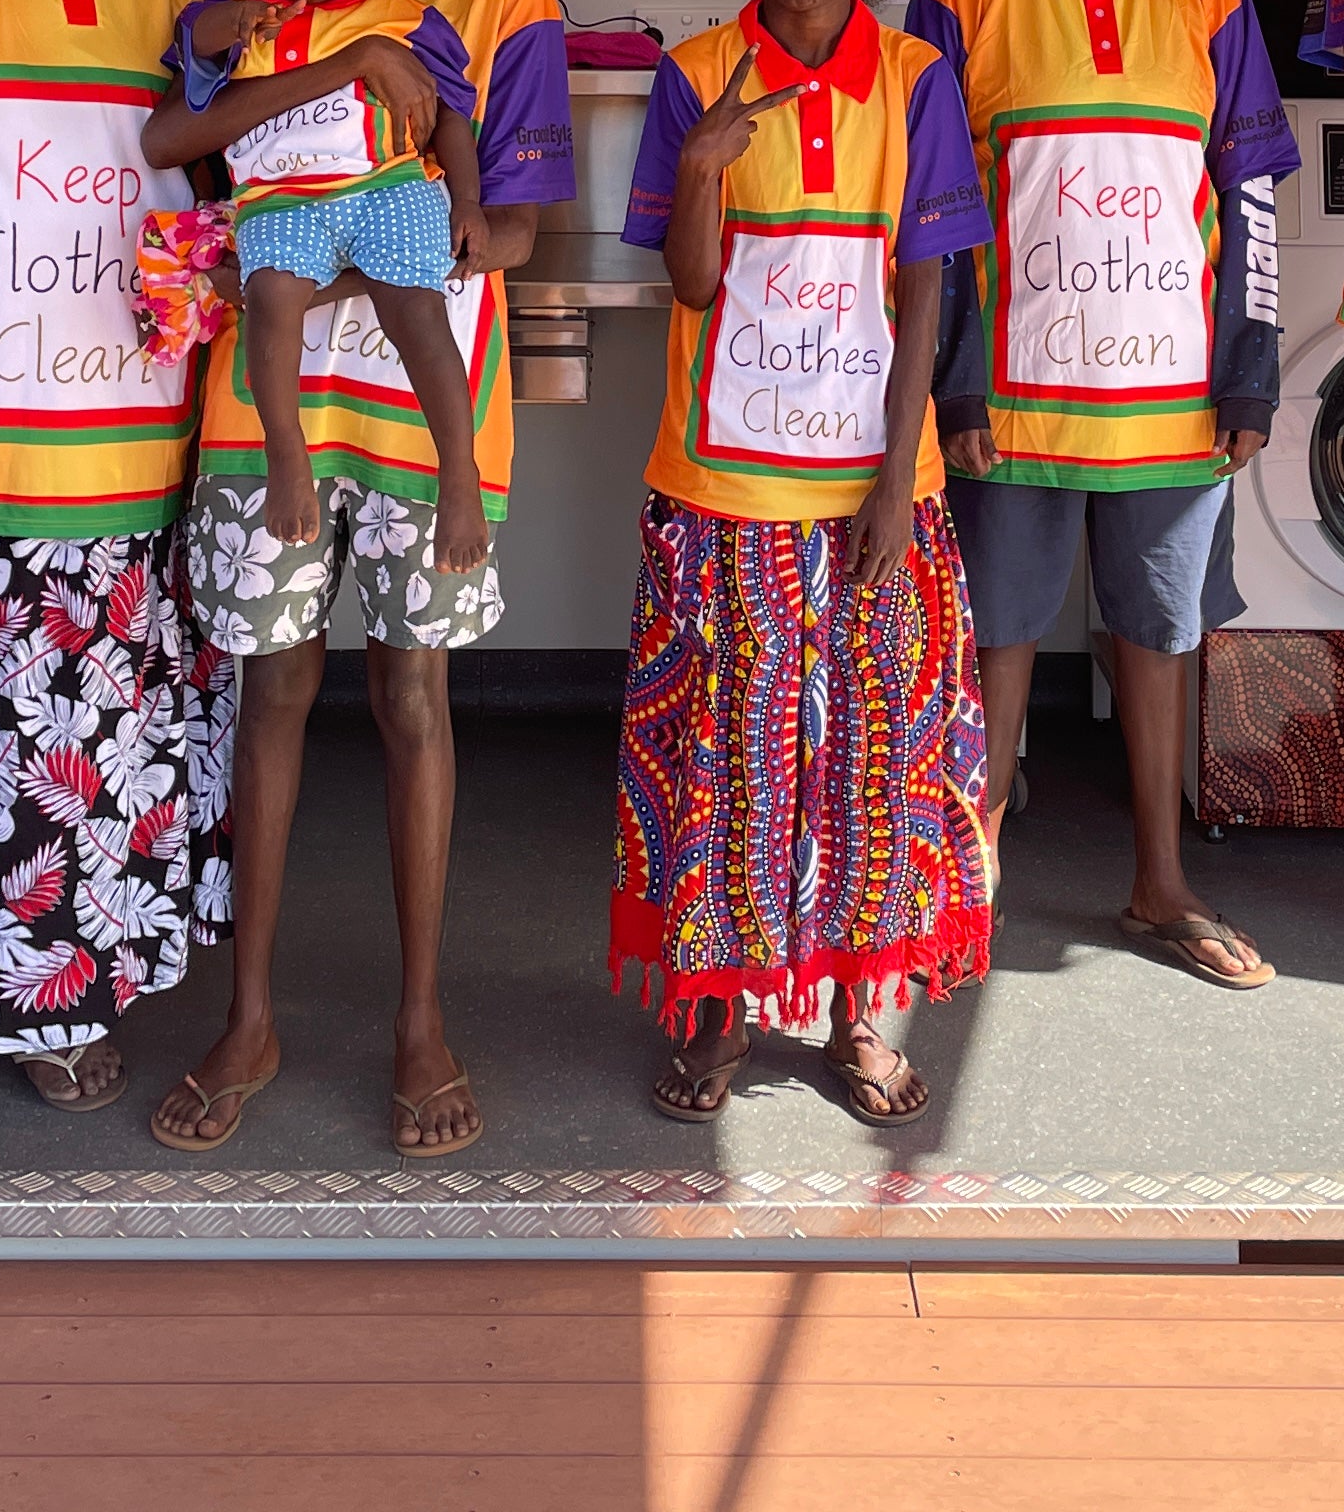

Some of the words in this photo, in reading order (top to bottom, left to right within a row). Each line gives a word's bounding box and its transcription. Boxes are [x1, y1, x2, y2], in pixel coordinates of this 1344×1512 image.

[16, 139, 141, 238] Keep
[917, 191, 956, 212] Groote
[1058, 167, 1161, 244] Keep
[1024, 235, 1189, 293] Clothes
[764, 264, 857, 333] Keep
[303, 301, 400, 364] lea
[729, 324, 881, 375] Clothes
[1043, 309, 1177, 368] Clean
[743, 384, 863, 442] Clean
